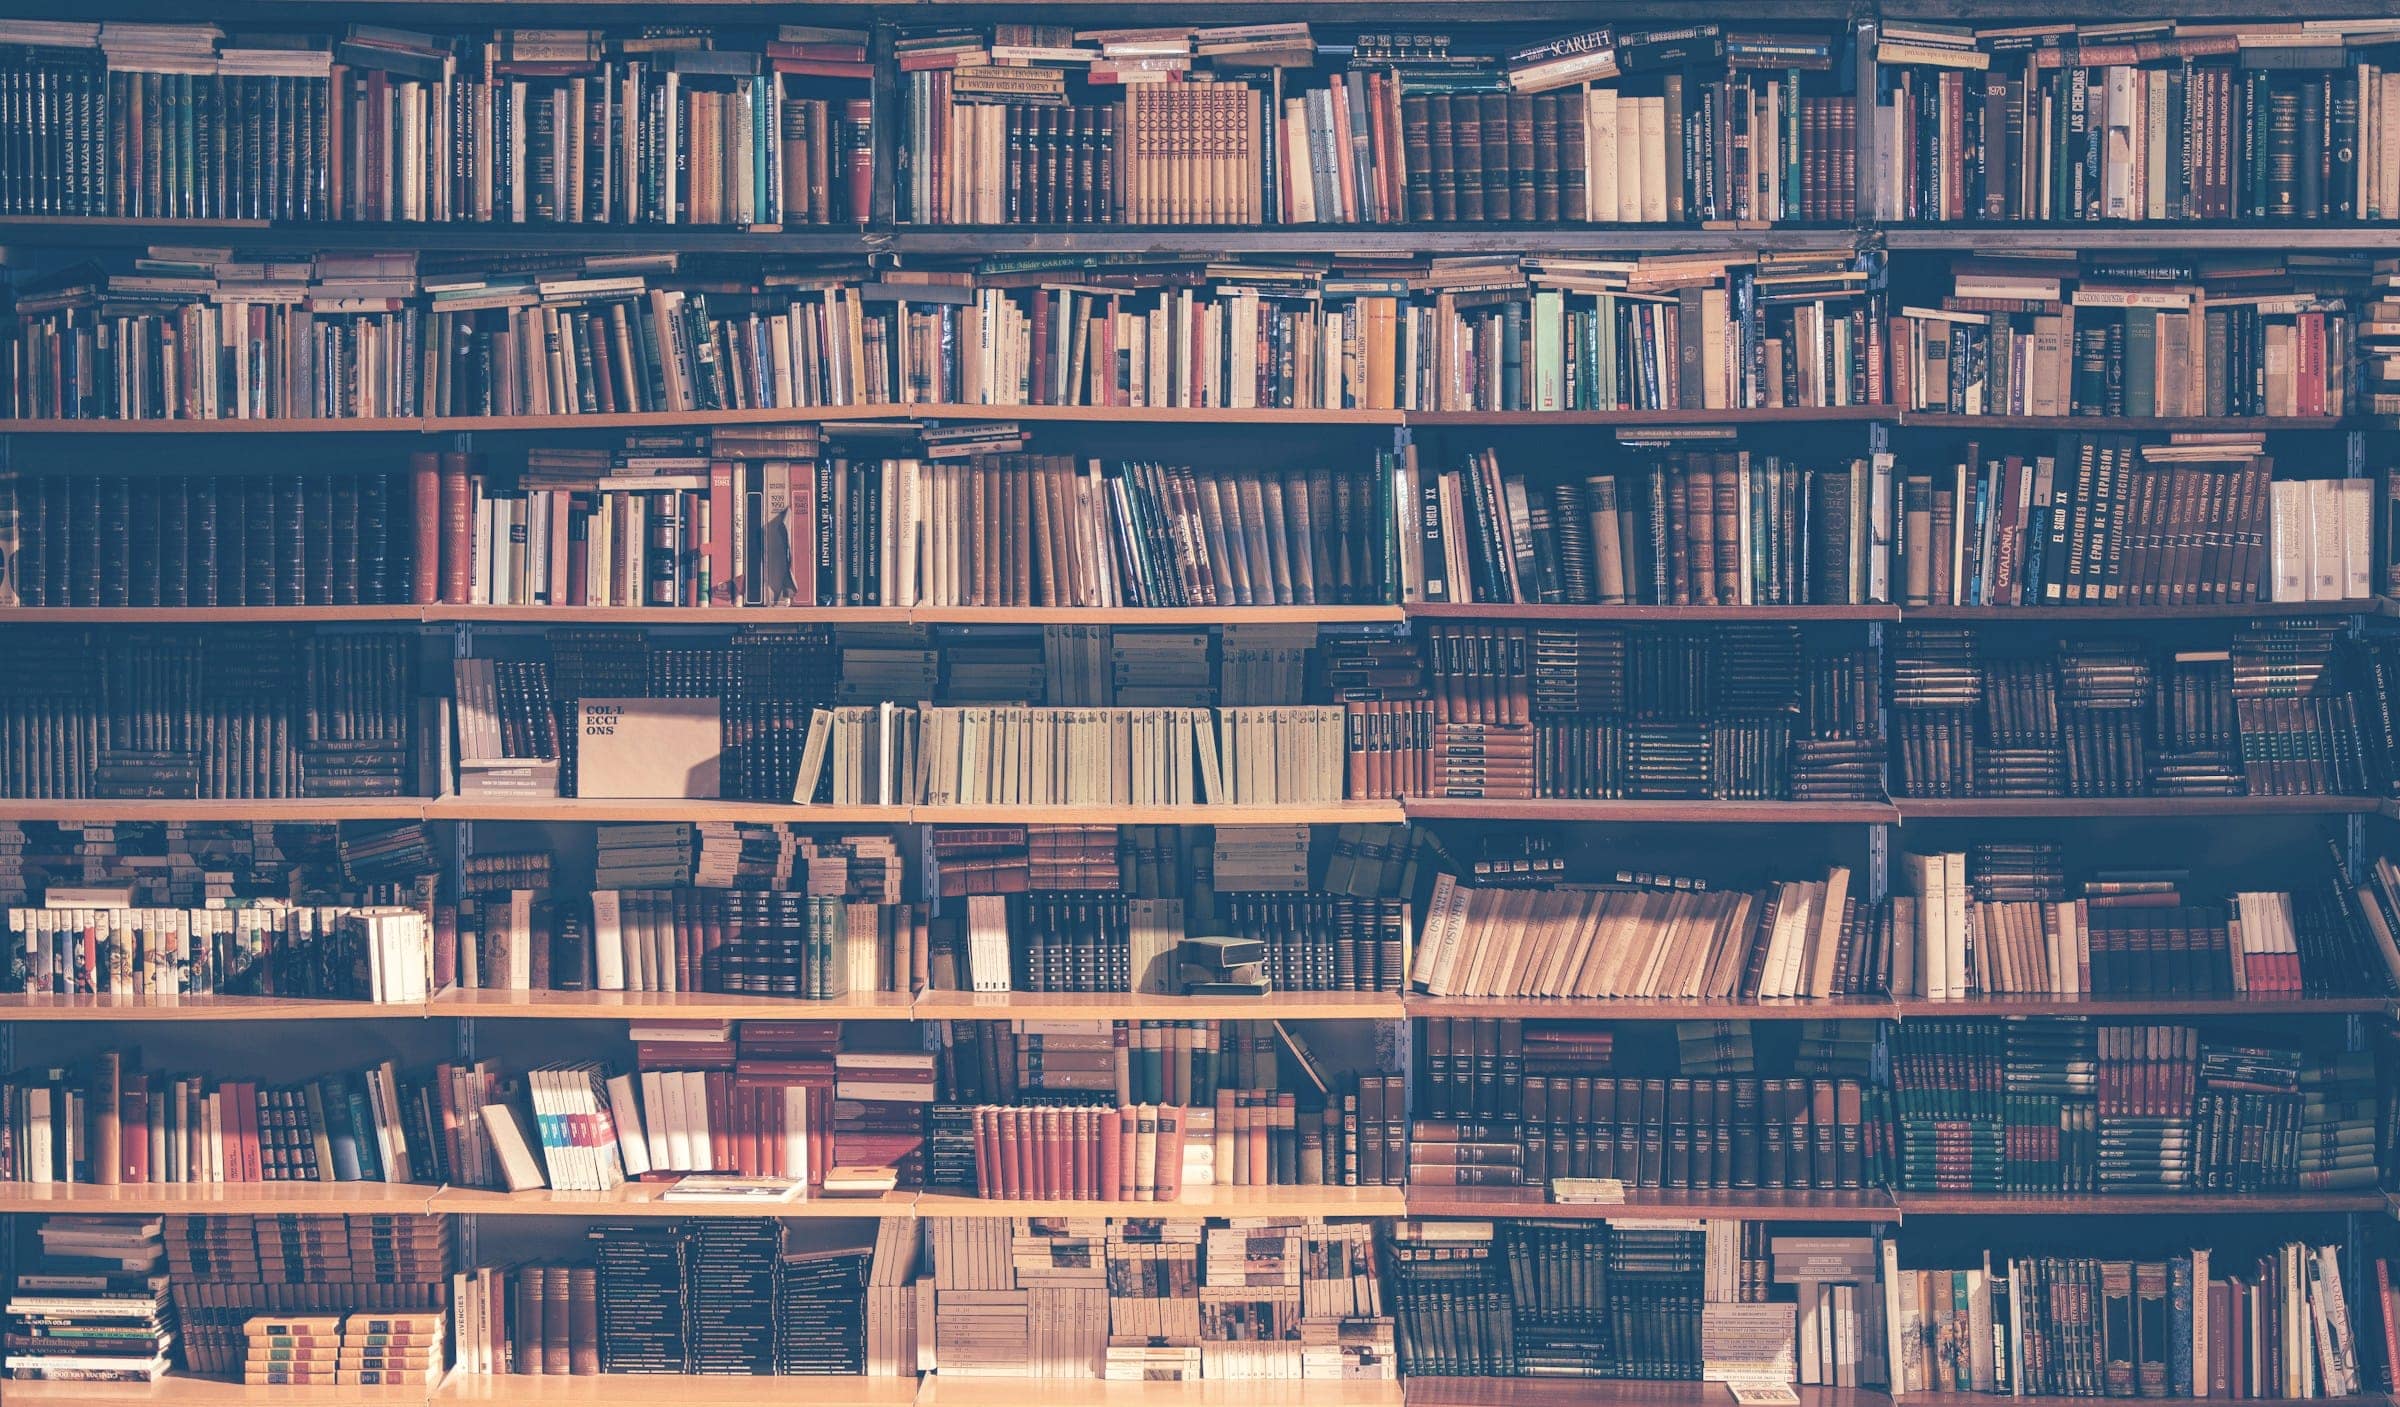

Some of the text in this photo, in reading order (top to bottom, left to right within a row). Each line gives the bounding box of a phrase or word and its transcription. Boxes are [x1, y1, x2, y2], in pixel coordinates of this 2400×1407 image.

[1550, 28, 1611, 58] SCARLETT
[1137, 90, 1147, 160] BRICOLAJE
[1148, 90, 1158, 160] BRICOLAJE
[1158, 90, 1168, 160] BRICOLAJE
[1169, 90, 1179, 160] BRICOLAJE
[1180, 90, 1190, 160] BRICOLAJE
[1190, 90, 1200, 160] BRICOLAJE
[1201, 90, 1211, 160] BRICOLAJE
[1214, 90, 1224, 160] BRICOLAJE
[1225, 90, 1235, 160] BRICOLAJE
[1237, 90, 1247, 160] BRICOLAJE
[1988, 86, 2006, 96] 1970
[2072, 70, 2085, 132] LAS CIENCIAS
[2196, 73, 2204, 166] RECORDS DE BARCELONA
[66, 92, 74, 193] LAS RAZAS HUMANAS
[81, 94, 89, 194] LAS RAZAS HUMANAS
[96, 94, 104, 194] LAS RAZAS HUMANAS
[1704, 94, 1713, 197] GRANDES EXPLORACIONES
[2206, 136, 2214, 167] PARADOR
[2206, 168, 2214, 185] FROM
[2219, 168, 2227, 184] FROM
[2220, 136, 2228, 166] PARADOR
[1042, 258, 1074, 266] GARDEN
[821, 467, 830, 566] HISTORIA DEL HOMBRE
[1425, 488, 1437, 538] EL SIGLO XX
[2053, 491, 2067, 542] EL SIGLO XX
[2070, 444, 2094, 574] CIVILIZACIONES EXTINGUIDAS
[2090, 448, 2113, 574] LA ÉPOCA DE LA EXPANSIÓN
[2108, 448, 2131, 574] LA CIVILIZACIÓN OCCIDENTAL
[1998, 526, 2014, 587] CATALONIA
[586, 716, 617, 725] ECCI
[586, 726, 614, 735] ONS
[1428, 882, 1450, 932] PARNASO
[1445, 895, 1465, 945] PARNASO
